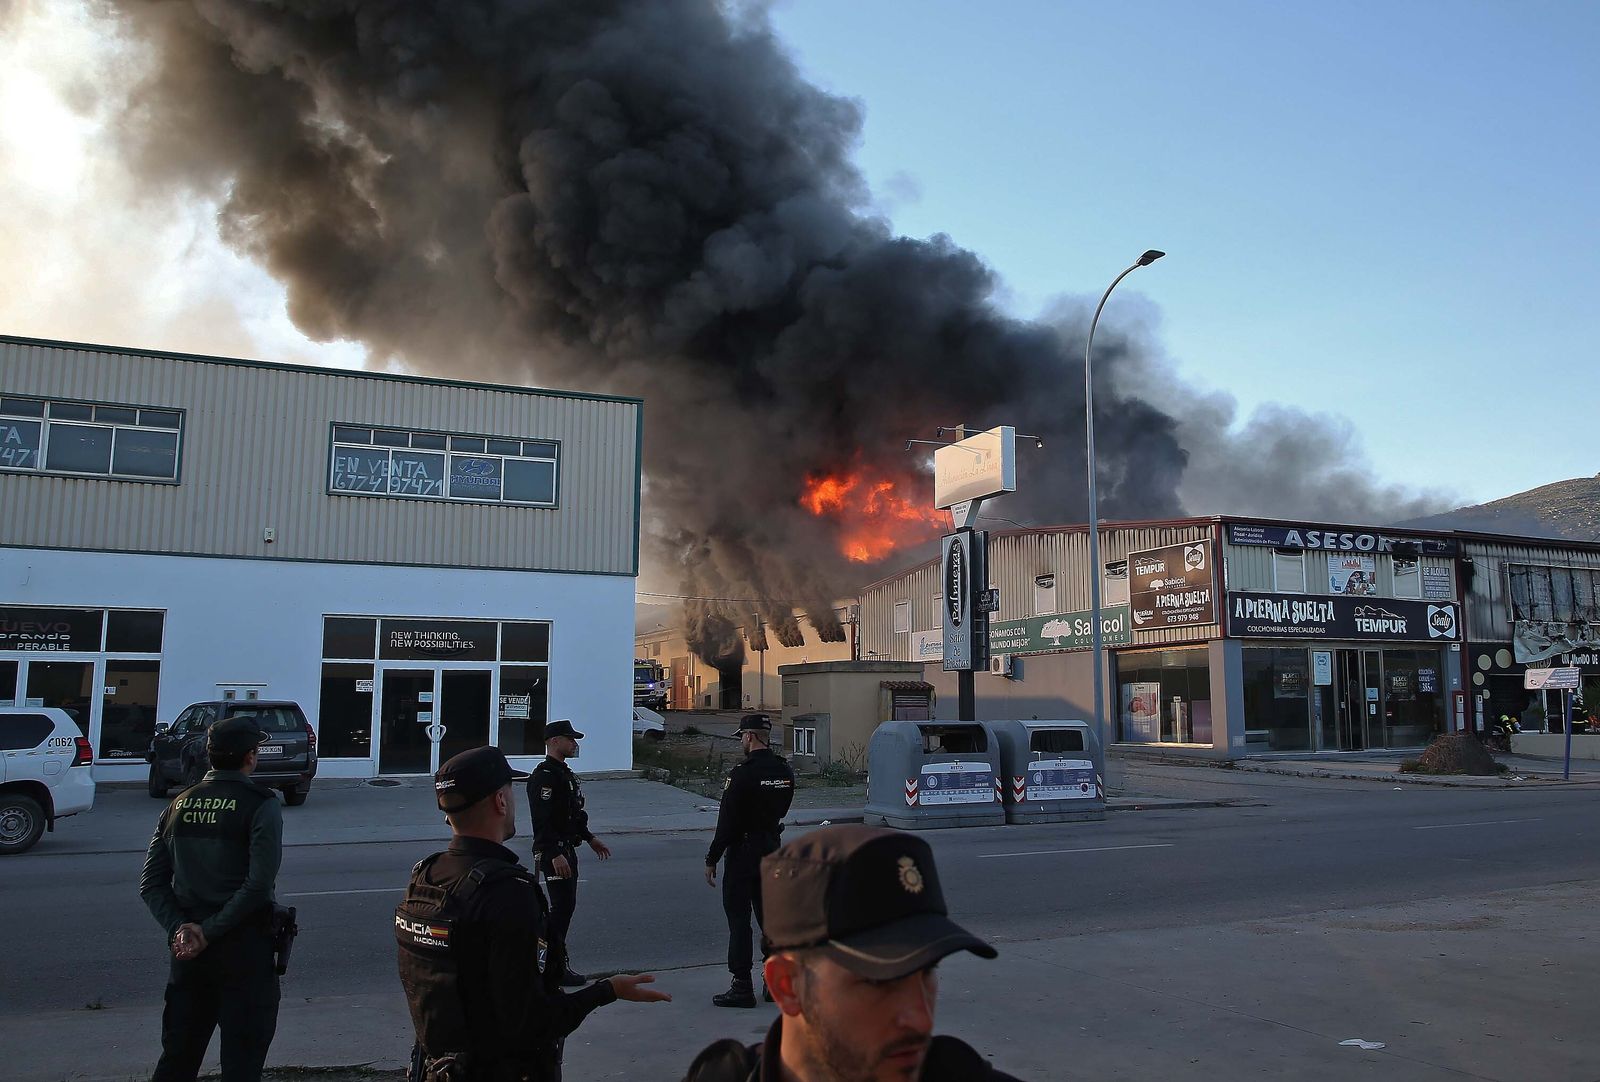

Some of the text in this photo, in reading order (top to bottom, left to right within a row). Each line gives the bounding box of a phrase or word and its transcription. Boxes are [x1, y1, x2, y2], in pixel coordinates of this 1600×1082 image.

[0, 447, 39, 467] 471
[336, 456, 428, 478] EN VENTA
[1284, 529, 1394, 552] ASESOR
[1135, 563, 1165, 575] TEMPUR
[1155, 589, 1210, 608] A PIERNA SUELTA
[1235, 598, 1336, 624] A PIERNA SUELTA
[1354, 618, 1407, 634] TEMPUR
[1431, 613, 1451, 629] Sealy
[391, 631, 460, 640] NEW THINKING.
[1013, 626, 1026, 636] CON
[390, 640, 476, 649] NEW POSSIBILITIES.
[990, 640, 1010, 649] MUNDO
[1074, 634, 1124, 645] COLONES
[17, 643, 70, 651] PERABLE
[55, 738, 72, 747] 062
[175, 798, 236, 811] GUARDIA
[183, 811, 217, 823] CIVIL
[413, 935, 449, 948] NACIONAL
